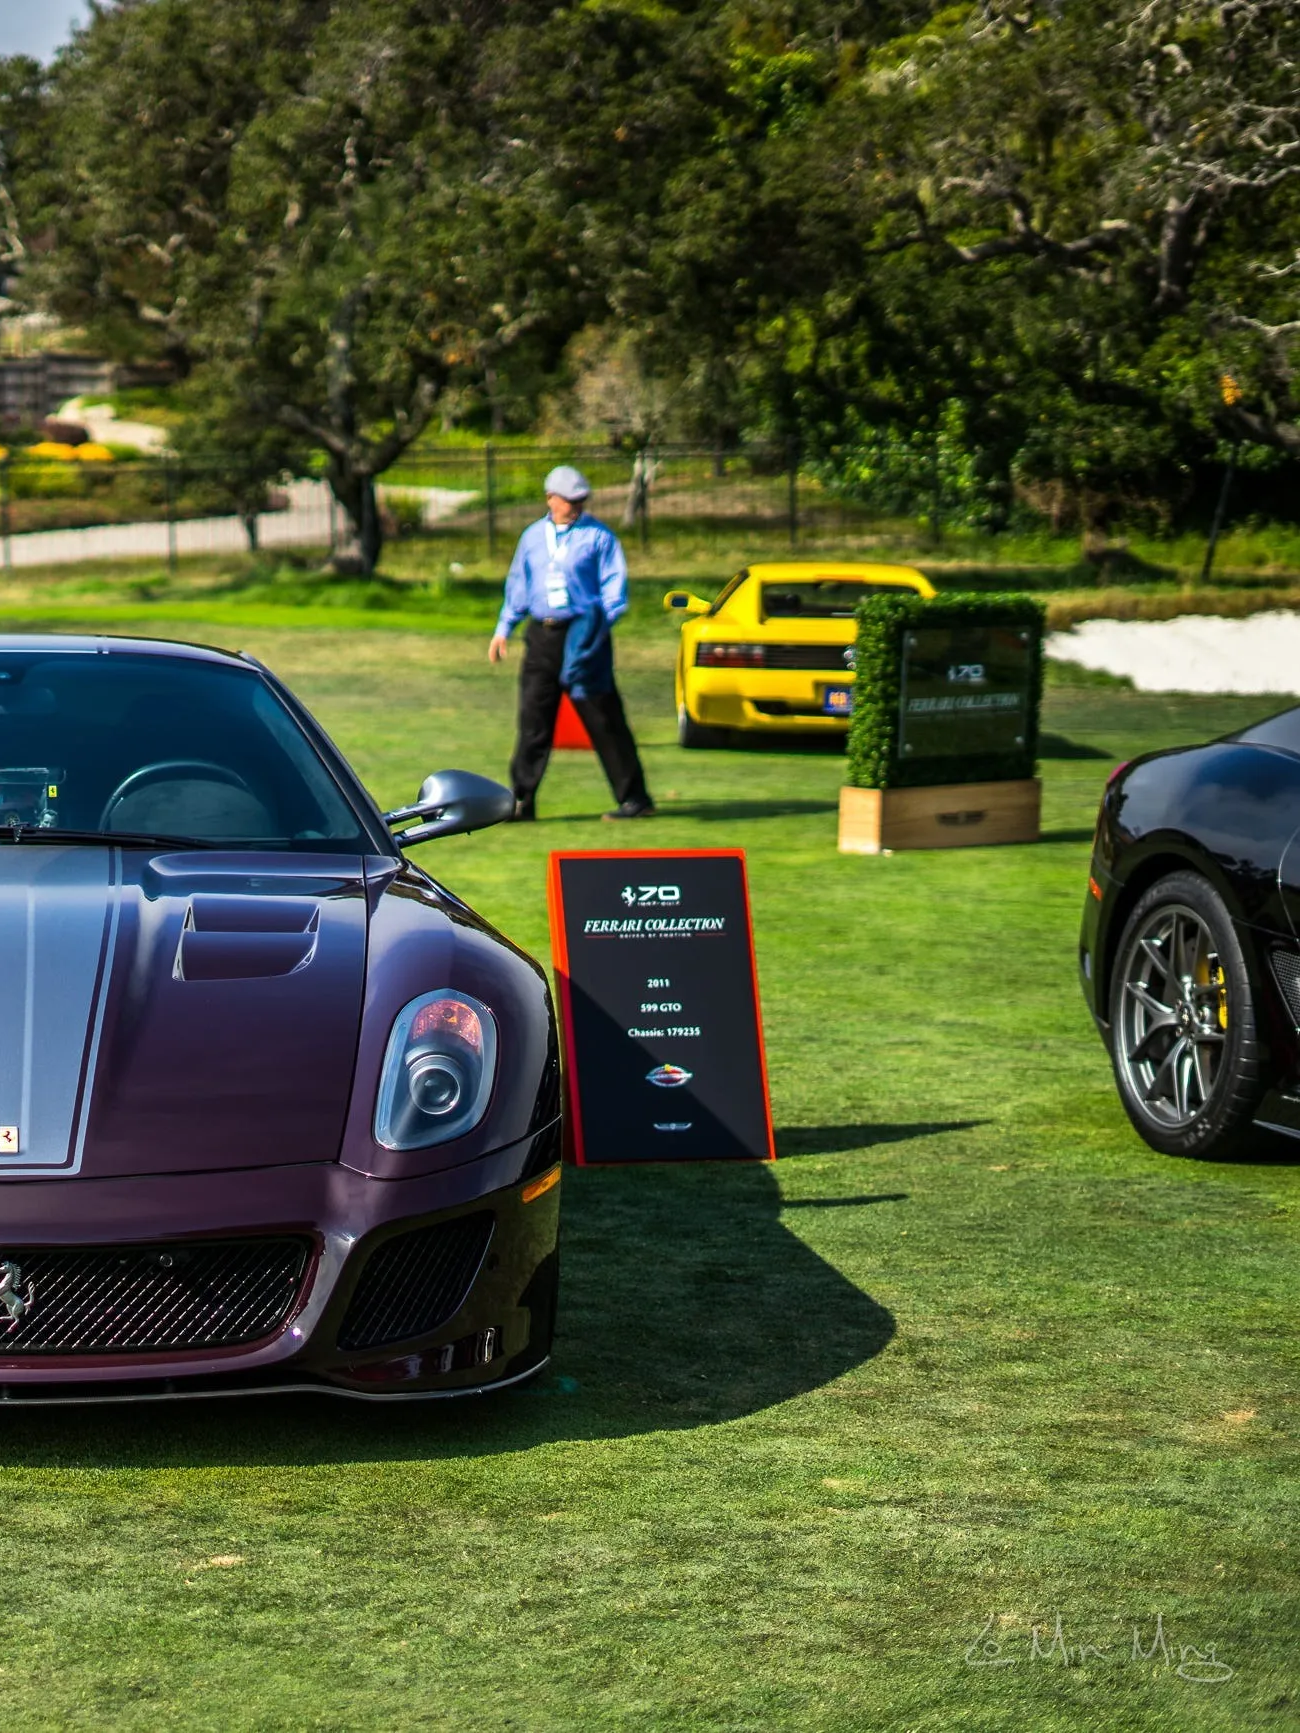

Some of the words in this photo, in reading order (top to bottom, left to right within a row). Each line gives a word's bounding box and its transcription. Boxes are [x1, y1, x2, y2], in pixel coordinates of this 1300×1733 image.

[637, 885, 681, 901] 70
[583, 919, 643, 933] FERRARI
[644, 917, 725, 931] COLLECTION
[646, 978, 670, 989] 2011
[640, 1003, 659, 1013] 599
[659, 1002, 682, 1013] GTO
[627, 1027, 665, 1038] Chassis:
[666, 1026, 701, 1037] 179235
